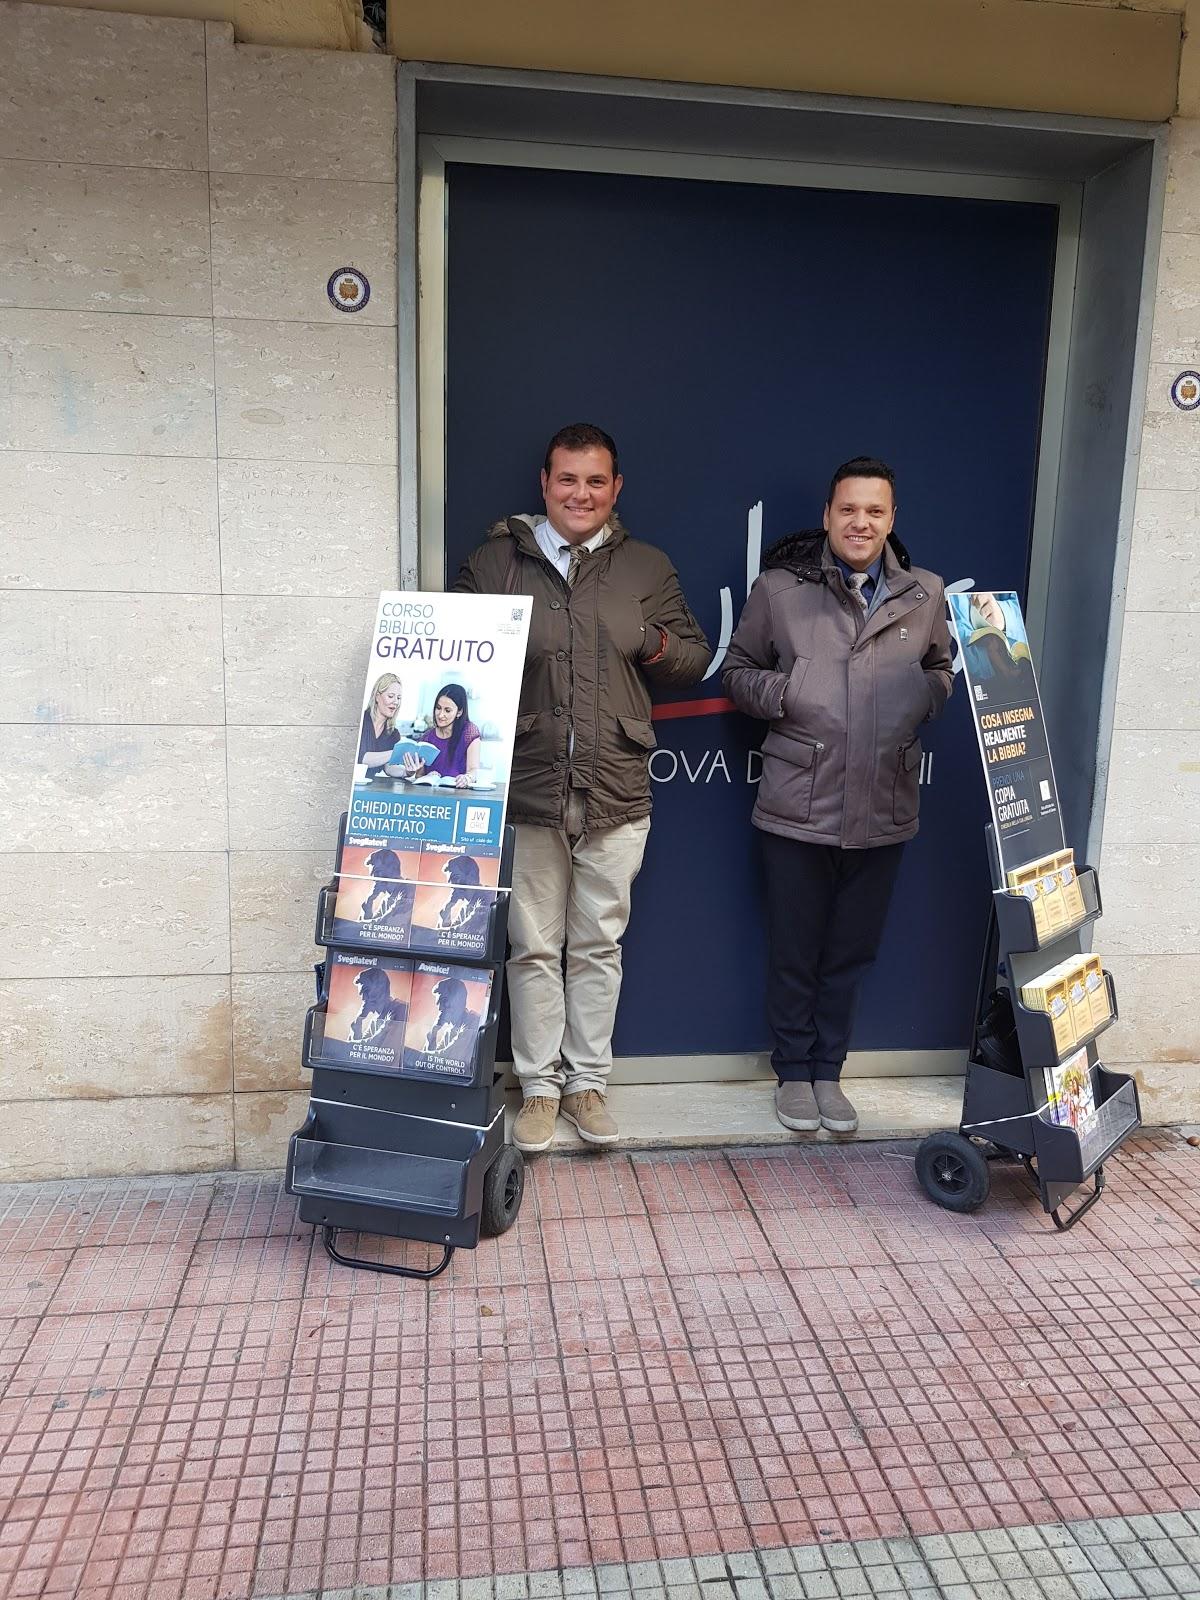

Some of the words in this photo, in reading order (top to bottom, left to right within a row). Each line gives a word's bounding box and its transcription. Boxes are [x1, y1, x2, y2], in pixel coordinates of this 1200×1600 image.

[382, 602, 434, 619] CORSO
[379, 619, 436, 636] BIBLICO
[376, 636, 495, 663] GRATUITO
[981, 712, 1002, 729] COSA
[1002, 707, 1034, 725] INSEGNA
[983, 725, 1026, 746] REALMENTE
[986, 746, 998, 763] LA
[998, 741, 1026, 760] BIBBIA?
[995, 785, 1016, 804] COPIA
[353, 800, 391, 815] CHIEDI
[394, 803, 405, 816] DI
[408, 804, 451, 820] ESSERE
[471, 811, 486, 820] JW
[998, 799, 1029, 821] GRATUITA
[351, 816, 425, 834] CONTATTATO
[360, 930, 371, 938] PER
[379, 932, 404, 941] MONDO?
[373, 925, 405, 933] SPERANZA
[437, 938, 449, 946] PER
[457, 940, 484, 949] MONDO?
[452, 932, 485, 942] SPERANZA
[337, 954, 378, 966] Svegliatevi!
[418, 962, 450, 975] Awake!
[350, 1051, 361, 1059] PER
[368, 1053, 394, 1062] MONDO?
[363, 1045, 394, 1055] SPERANZA
[434, 1056, 445, 1064] THE
[445, 1059, 465, 1069] WORLD
[435, 1064, 465, 1074] CONTROL?
